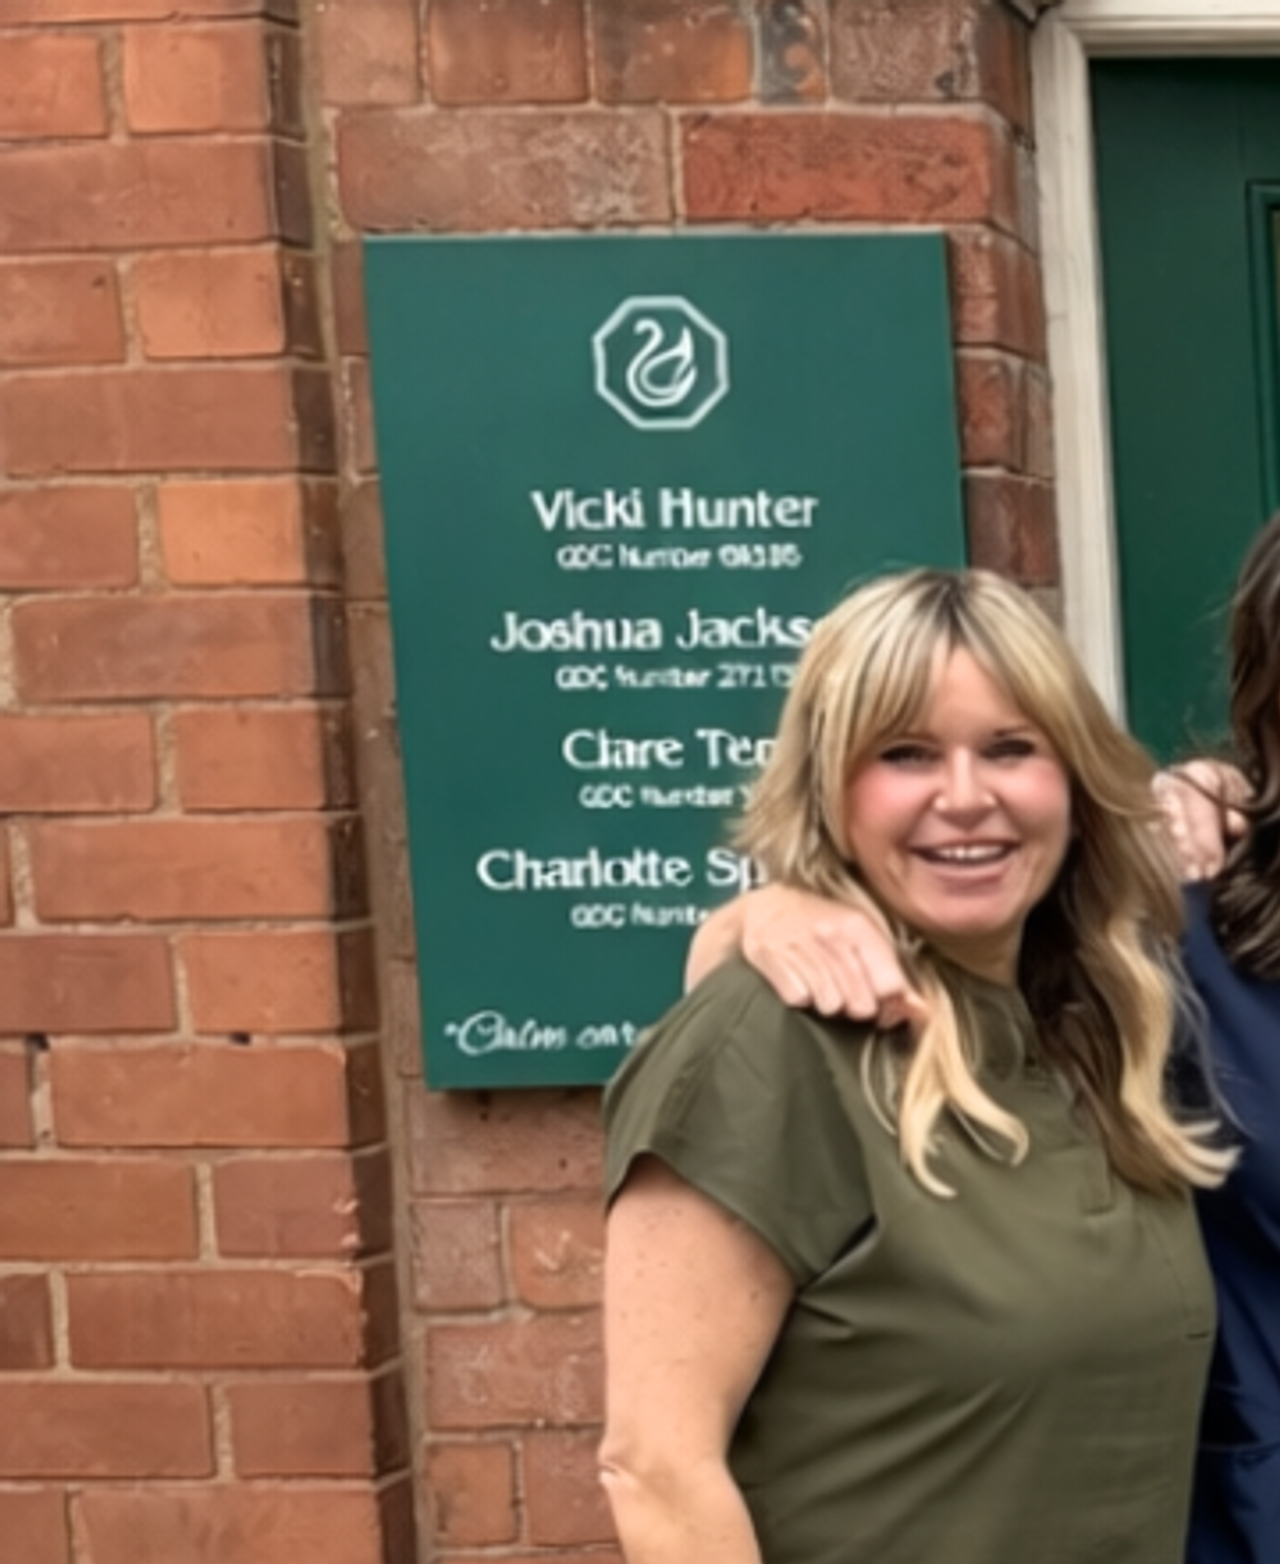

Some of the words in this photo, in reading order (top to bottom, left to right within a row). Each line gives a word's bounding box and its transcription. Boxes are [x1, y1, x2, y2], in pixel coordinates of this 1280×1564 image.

[531, 487, 645, 531] Vicki
[659, 487, 818, 529] Hunter
[490, 610, 662, 652] Joshua
[562, 728, 684, 770] Clare
[476, 848, 693, 891] Charlotte
